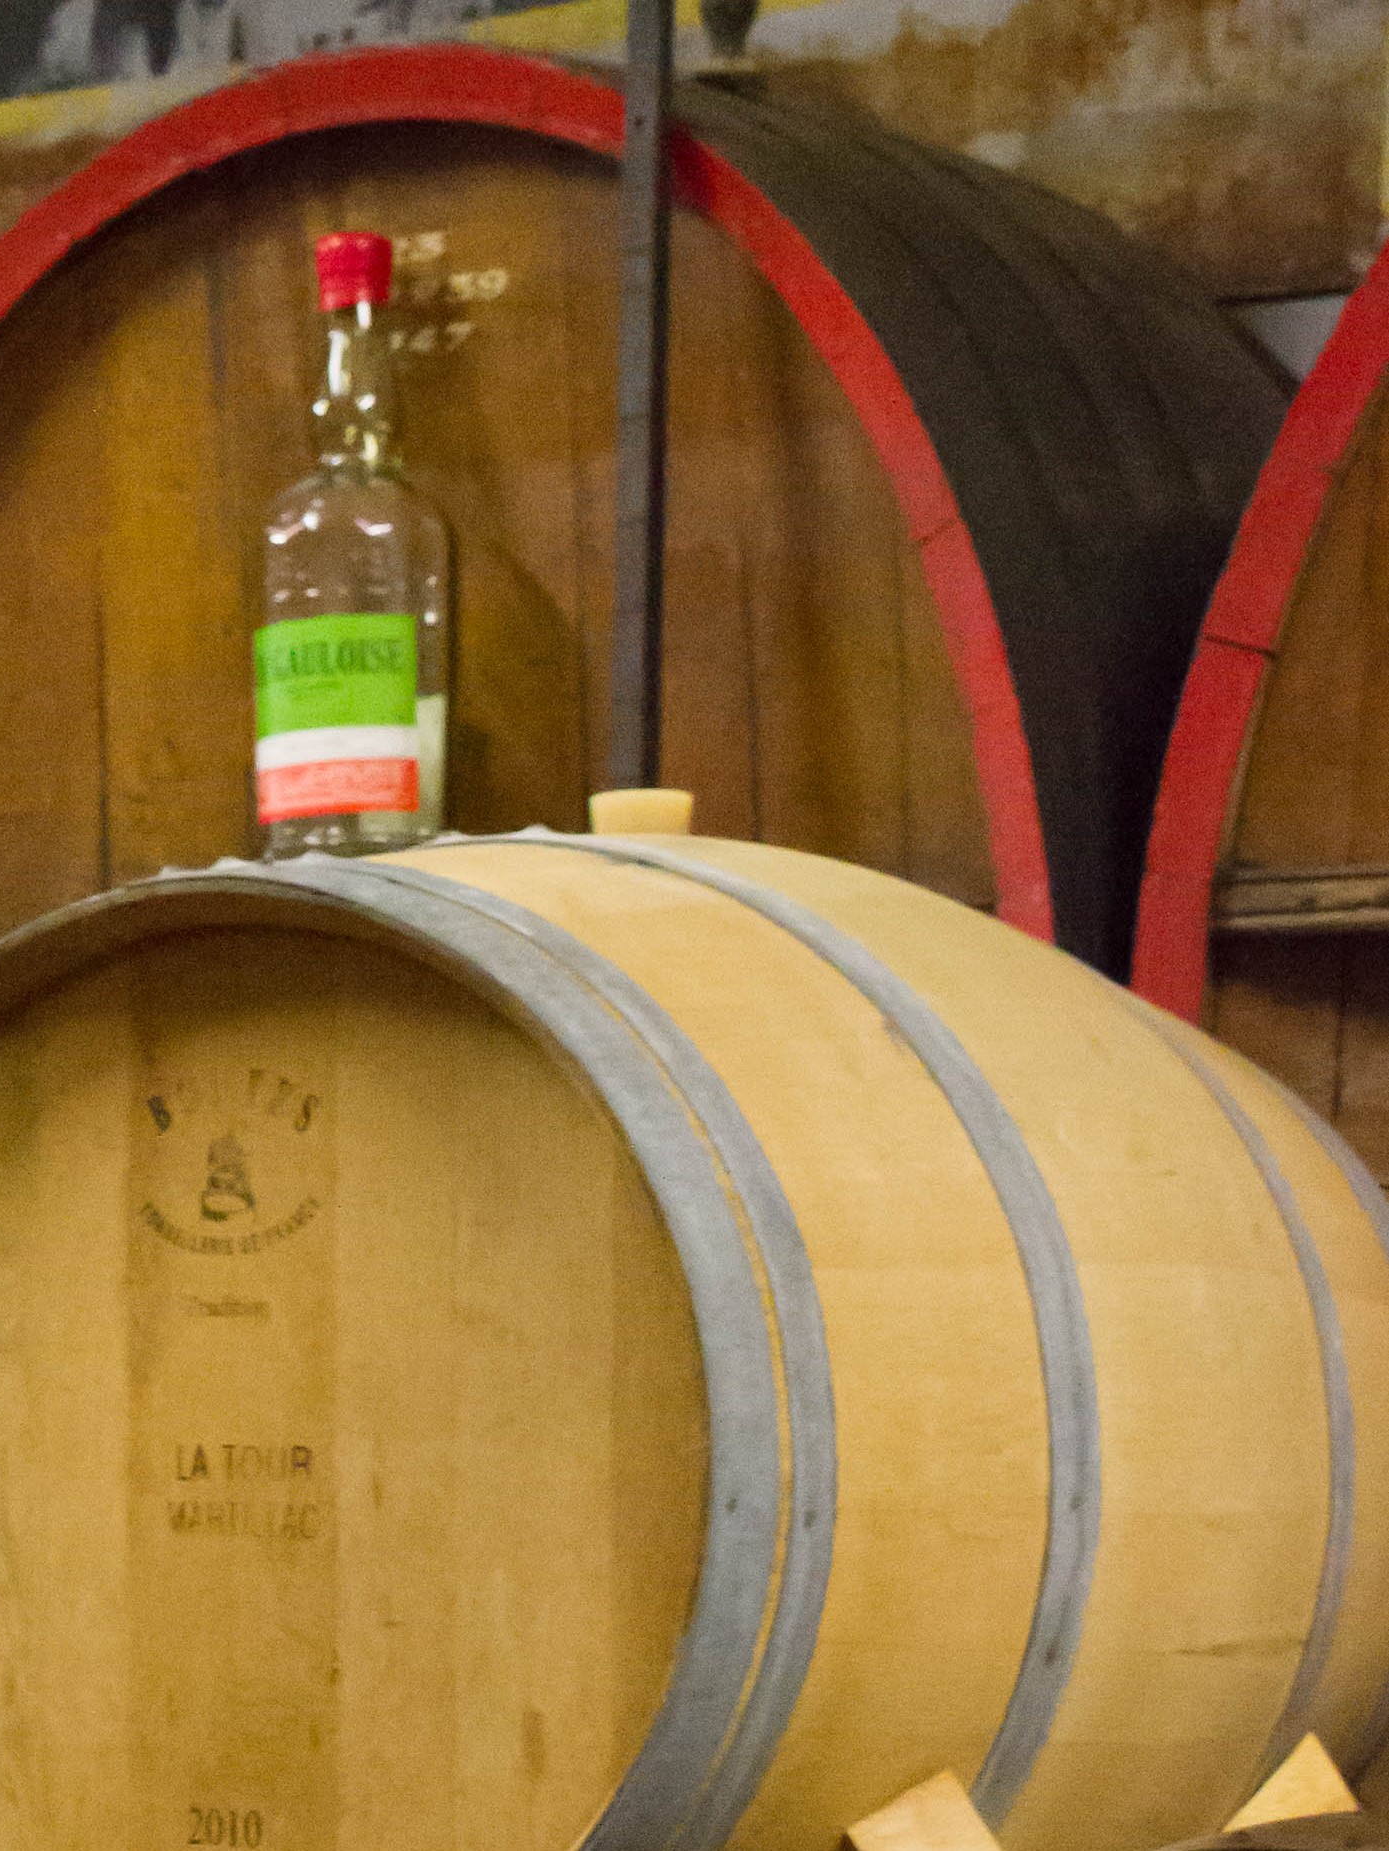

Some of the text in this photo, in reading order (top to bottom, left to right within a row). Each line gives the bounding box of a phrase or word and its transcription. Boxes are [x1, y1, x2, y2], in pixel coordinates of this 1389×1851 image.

[176, 1443, 313, 1482] LA TOUR
[187, 1807, 263, 1849] 2010
